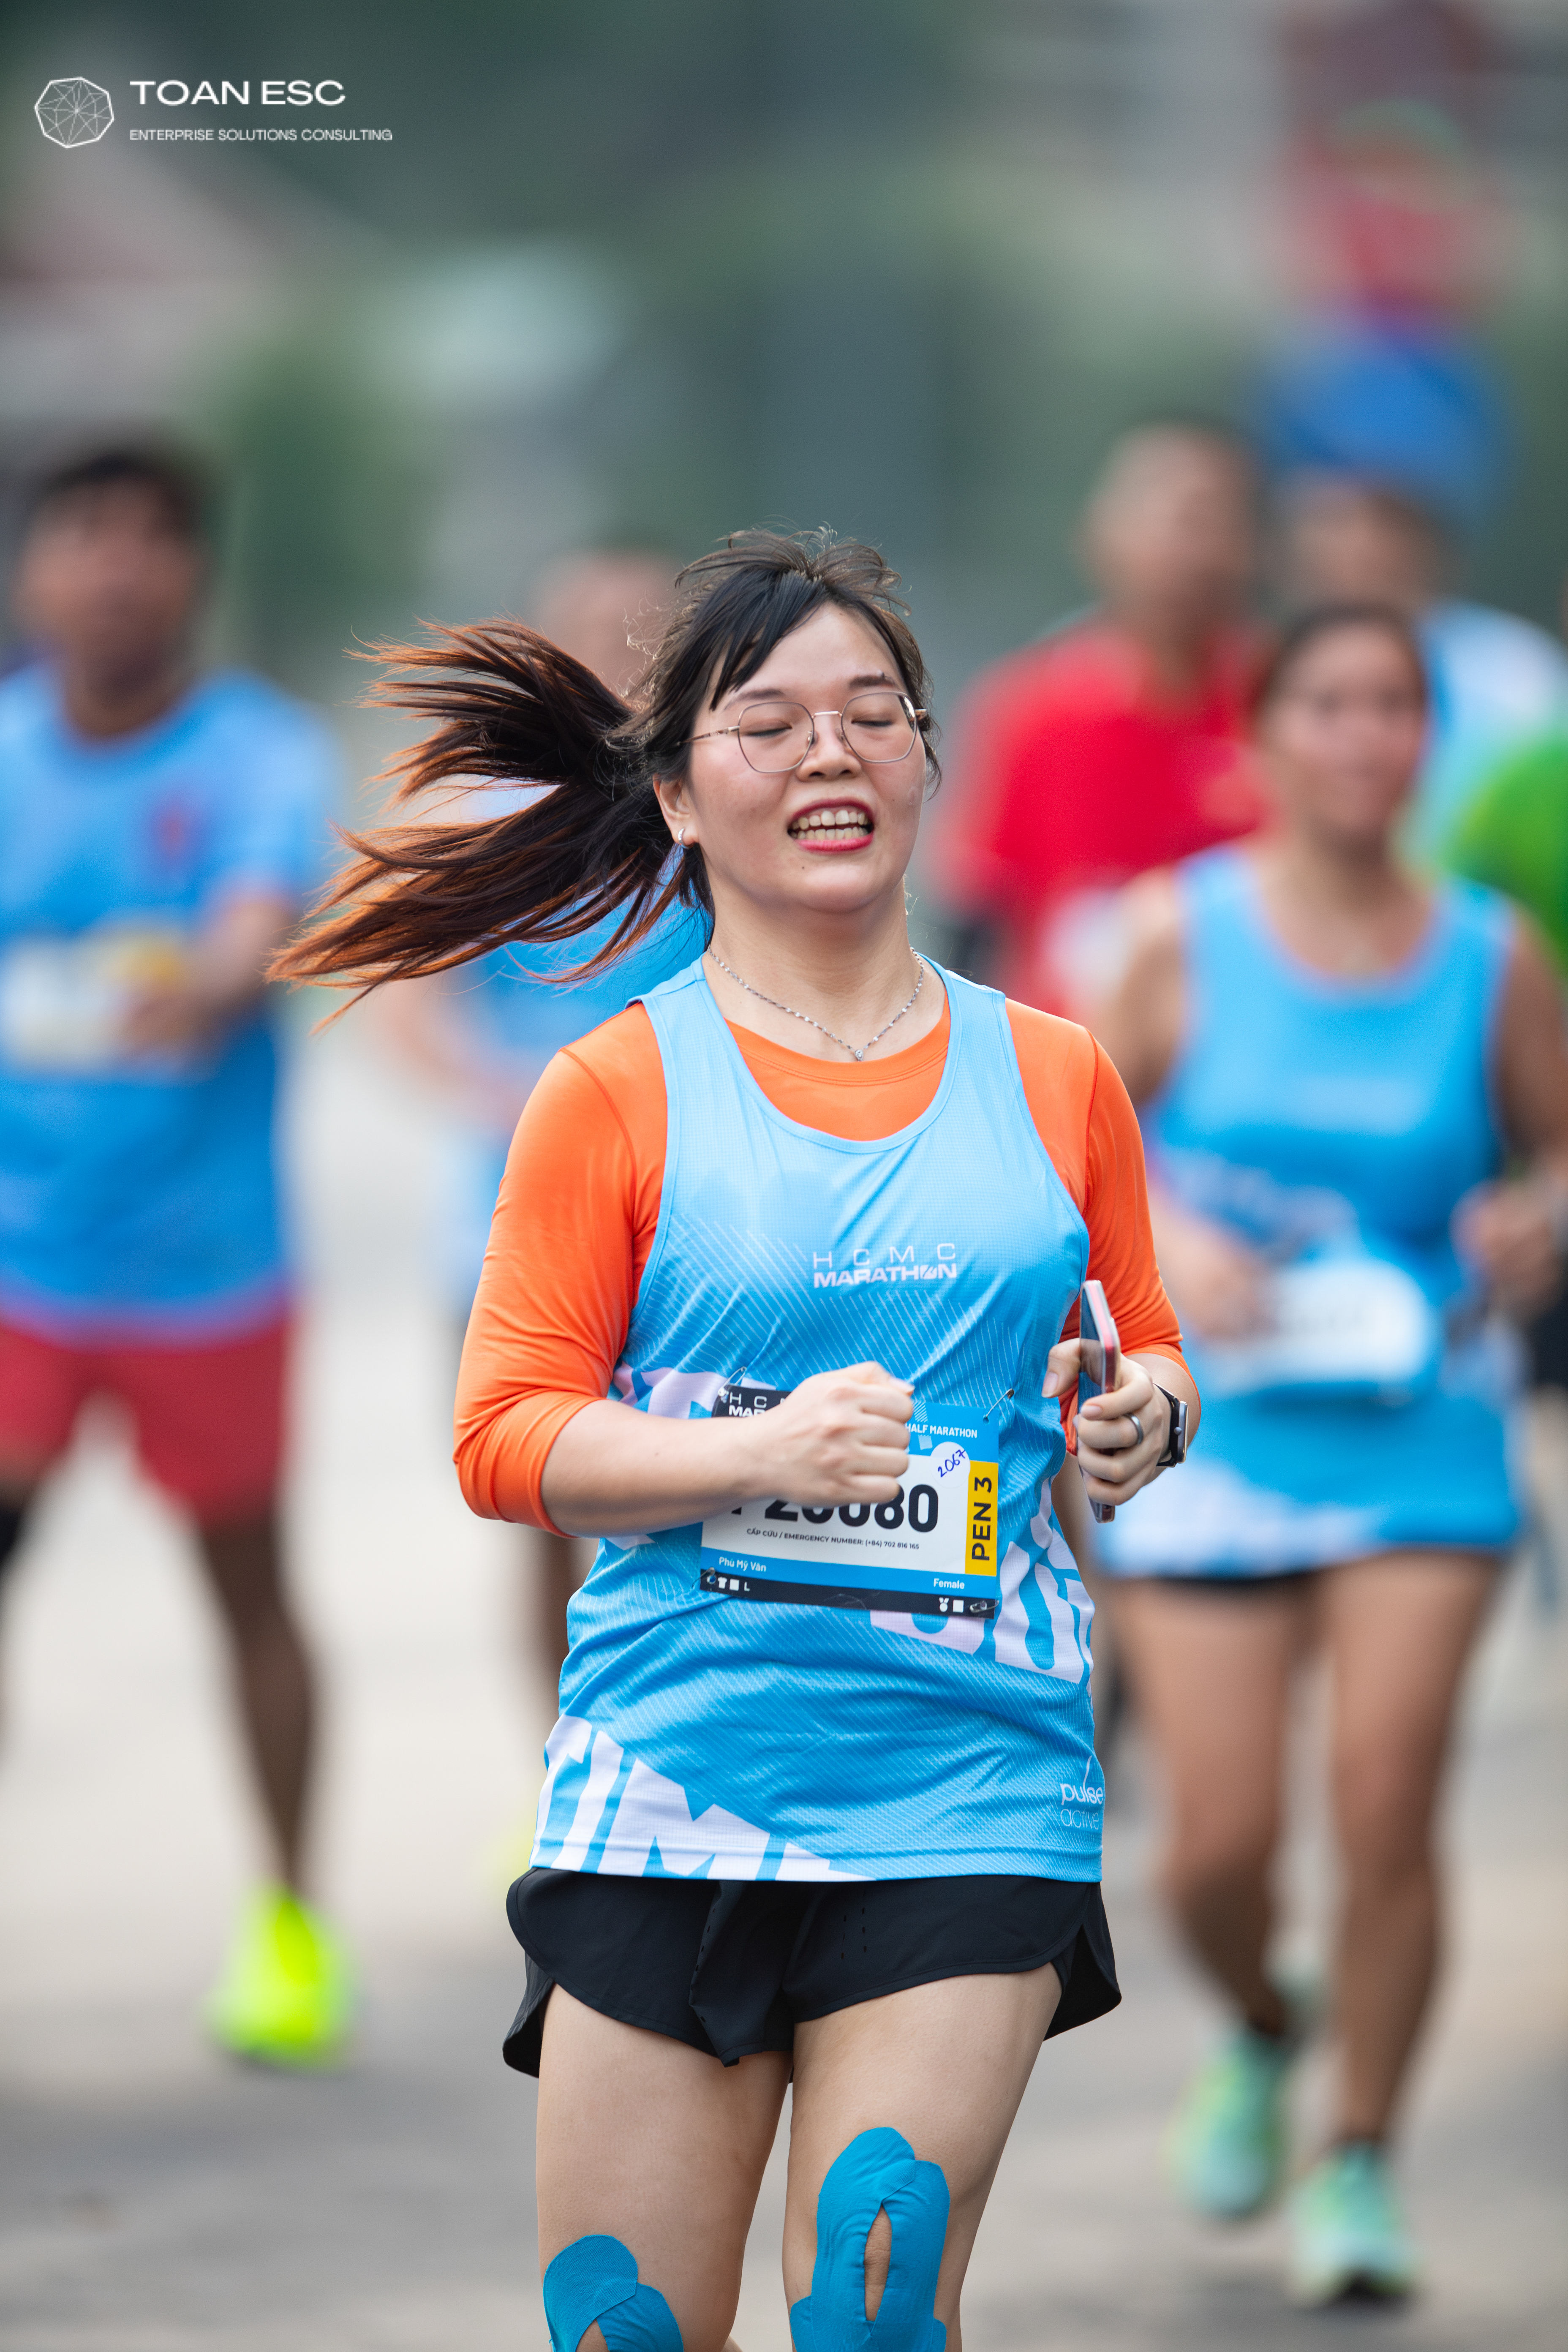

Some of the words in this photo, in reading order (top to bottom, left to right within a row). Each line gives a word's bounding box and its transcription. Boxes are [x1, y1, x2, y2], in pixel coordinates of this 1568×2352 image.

[814, 1263, 957, 1289] MARATHON
[905, 1423, 928, 1433] HALF
[929, 1425, 977, 1438] MARATHON
[938, 1449, 965, 1478] 2067
[974, 1477, 992, 1493] 3
[784, 1533, 830, 1542] EMERGENCY
[831, 1536, 863, 1546] NUMBER:
[865, 1539, 882, 1548] (+84)
[972, 1502, 991, 1561] PEN
[743, 1582, 750, 1592] L
[933, 1578, 965, 1590] Female
[1060, 1756, 1103, 1805] pulse
[1061, 1808, 1099, 1830] active
